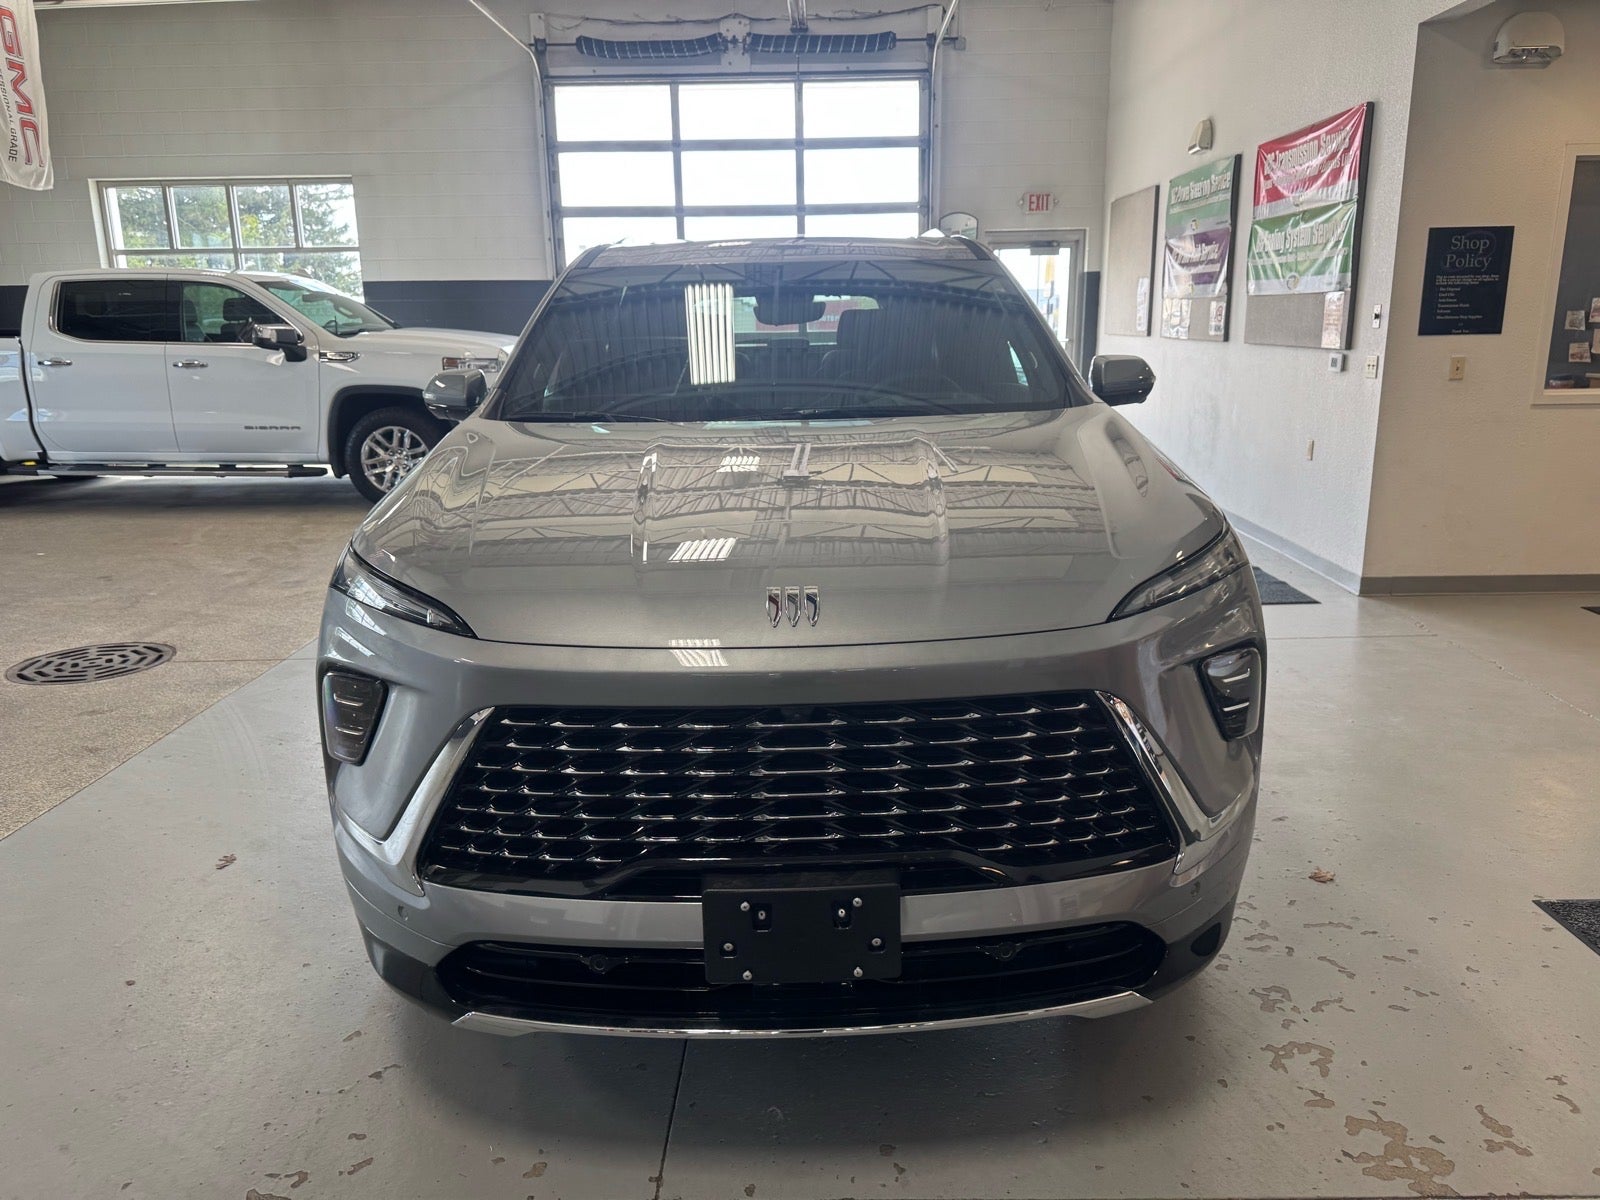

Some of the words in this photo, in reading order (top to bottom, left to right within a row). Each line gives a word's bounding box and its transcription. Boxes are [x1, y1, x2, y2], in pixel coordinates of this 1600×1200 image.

[0, 7, 46, 168] GMC
[8, 127, 18, 162] GRADE
[1028, 193, 1051, 212] EXIT
[1451, 235, 1490, 253] Shop
[1445, 253, 1492, 272] Policy
